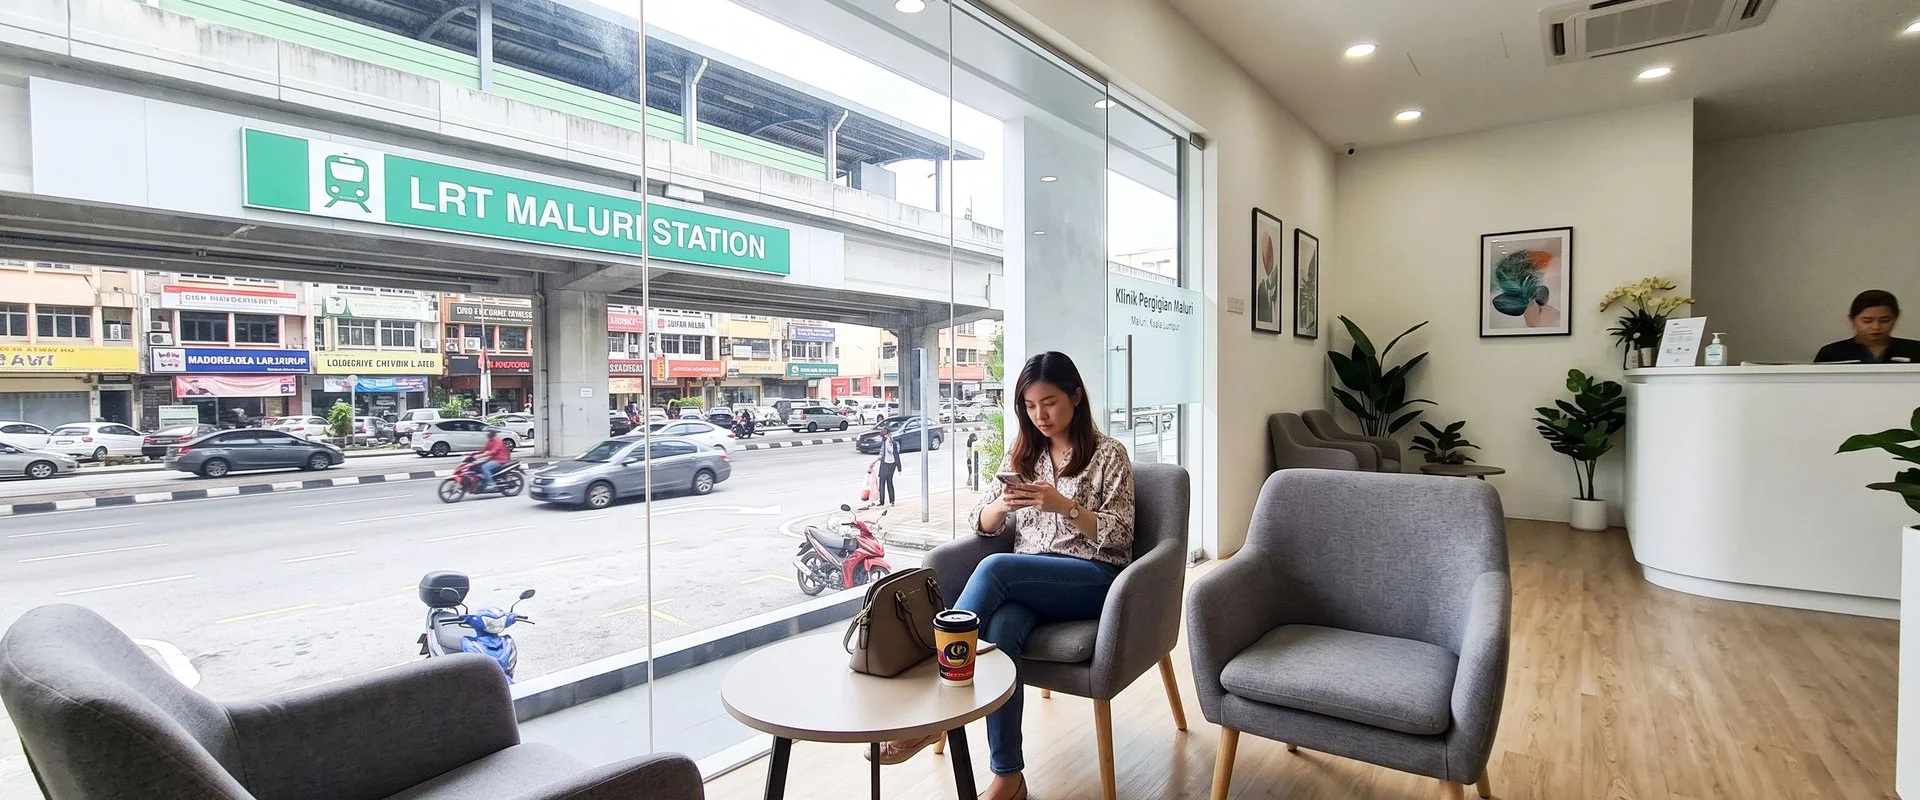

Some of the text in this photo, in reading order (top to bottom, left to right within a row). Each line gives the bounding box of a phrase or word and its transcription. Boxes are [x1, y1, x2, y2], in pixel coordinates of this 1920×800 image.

[410, 176, 766, 260] LRT MALURI STATION
[1115, 287, 1194, 315] Klinik Pergigian Maluri
